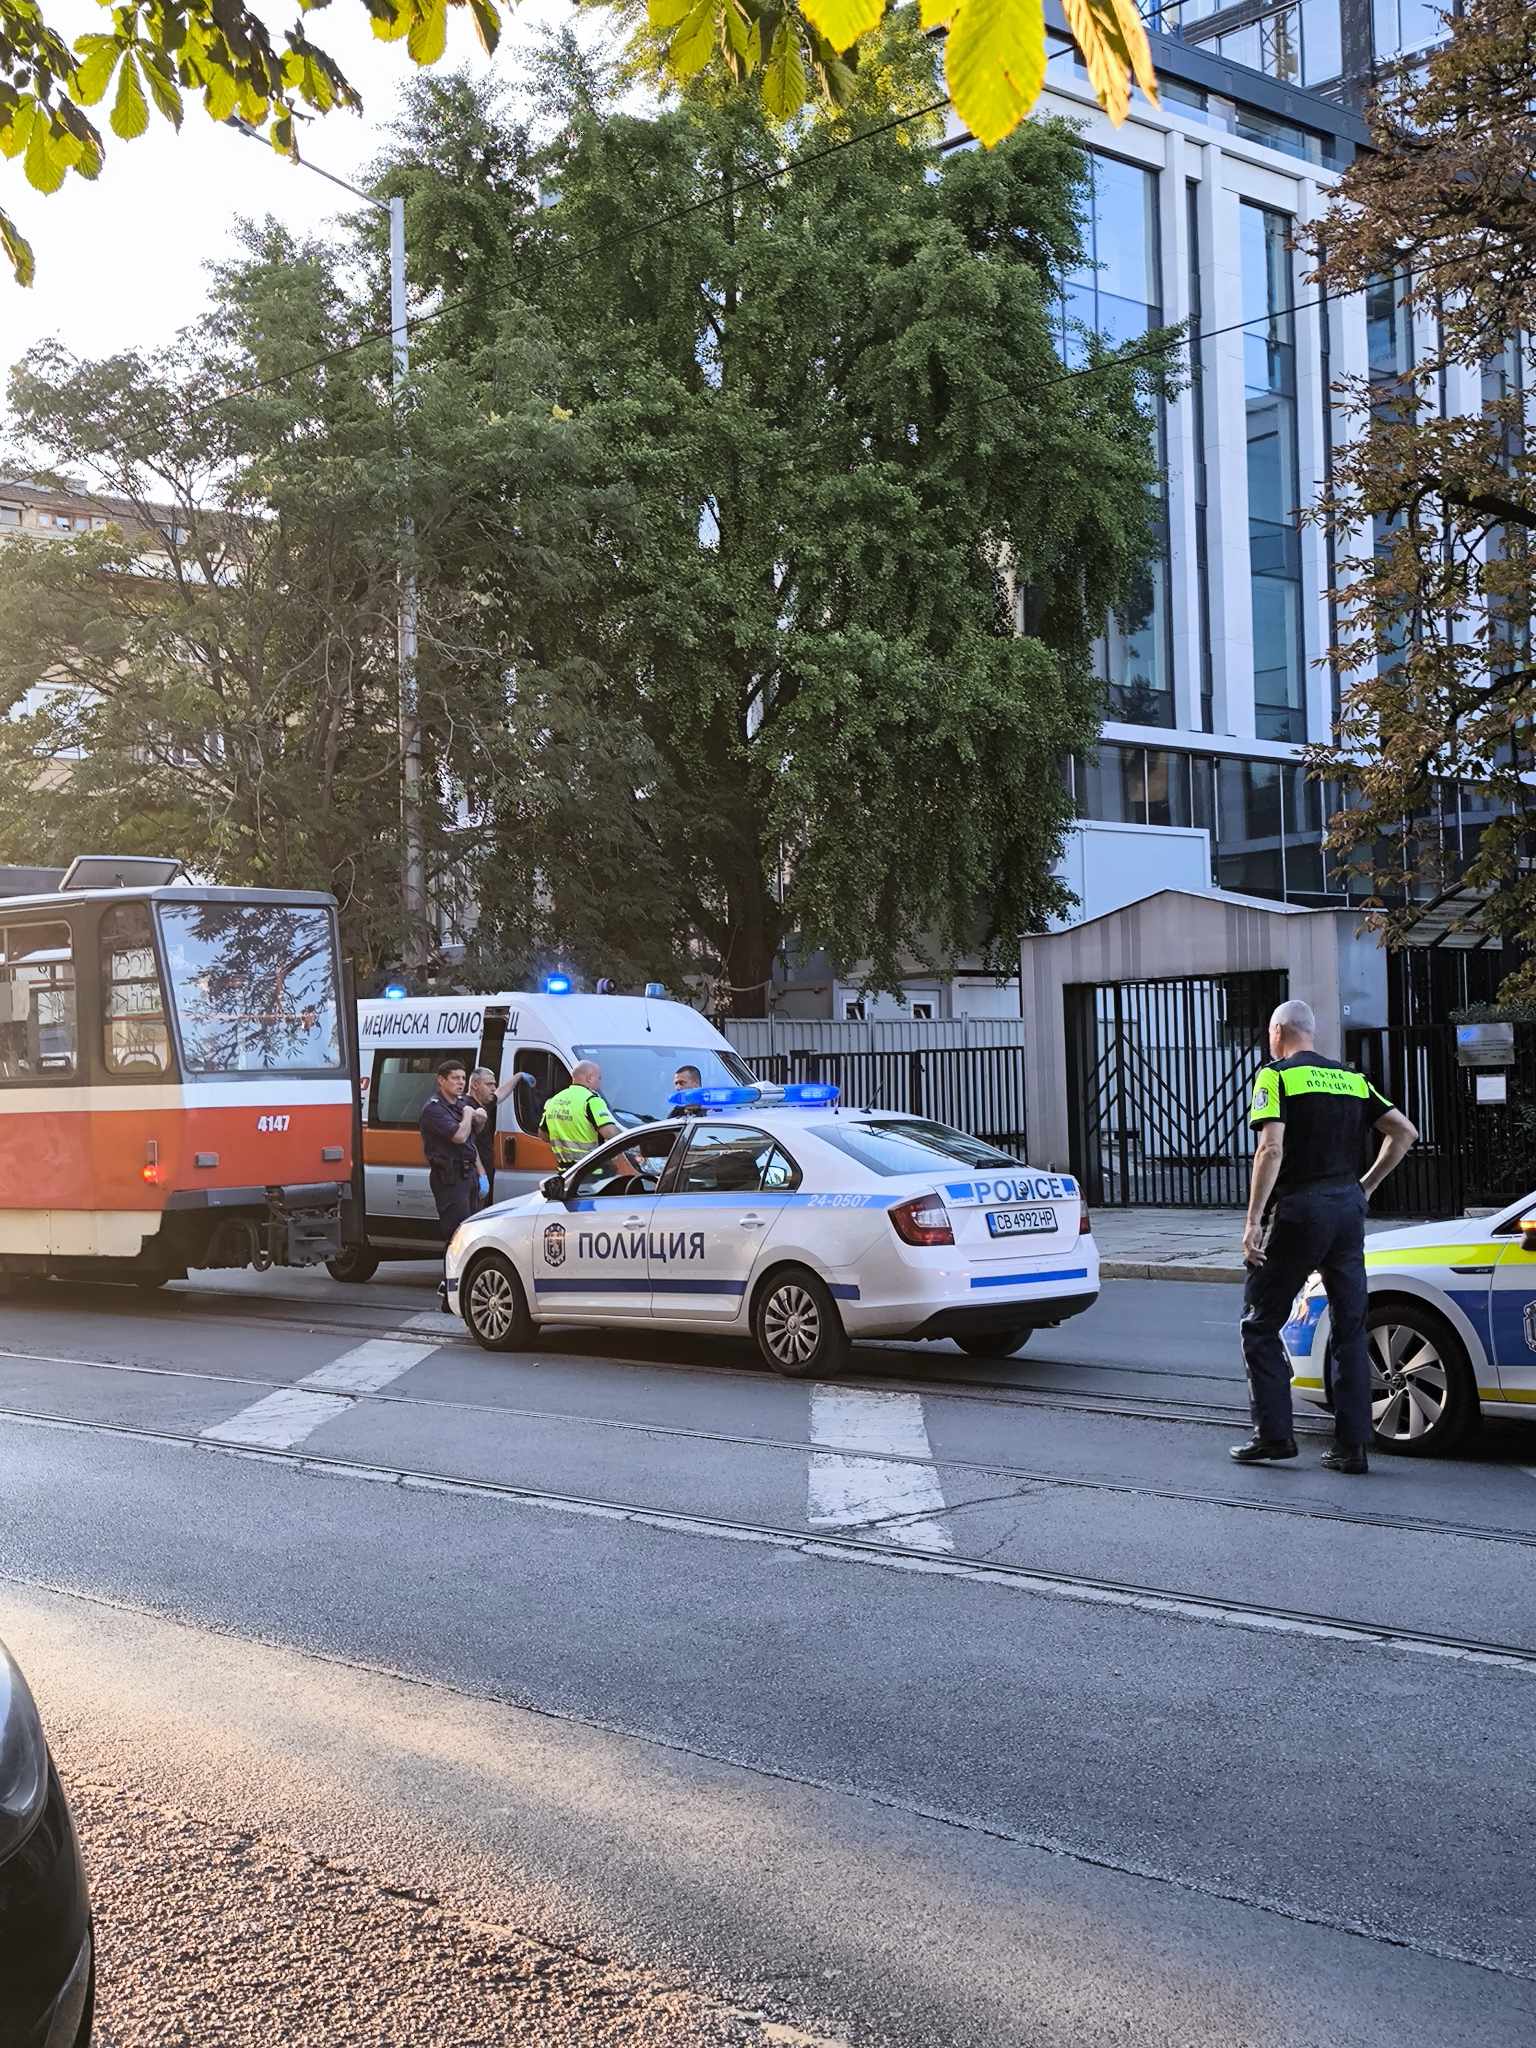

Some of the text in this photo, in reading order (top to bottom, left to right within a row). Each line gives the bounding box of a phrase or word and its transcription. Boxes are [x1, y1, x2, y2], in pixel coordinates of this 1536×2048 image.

[258, 1115, 290, 1131] 4147
[807, 1194, 872, 1207] 24-0507
[974, 1178, 1062, 1203] POLICE
[579, 1232, 705, 1263] ПОЛИЦИЯ
